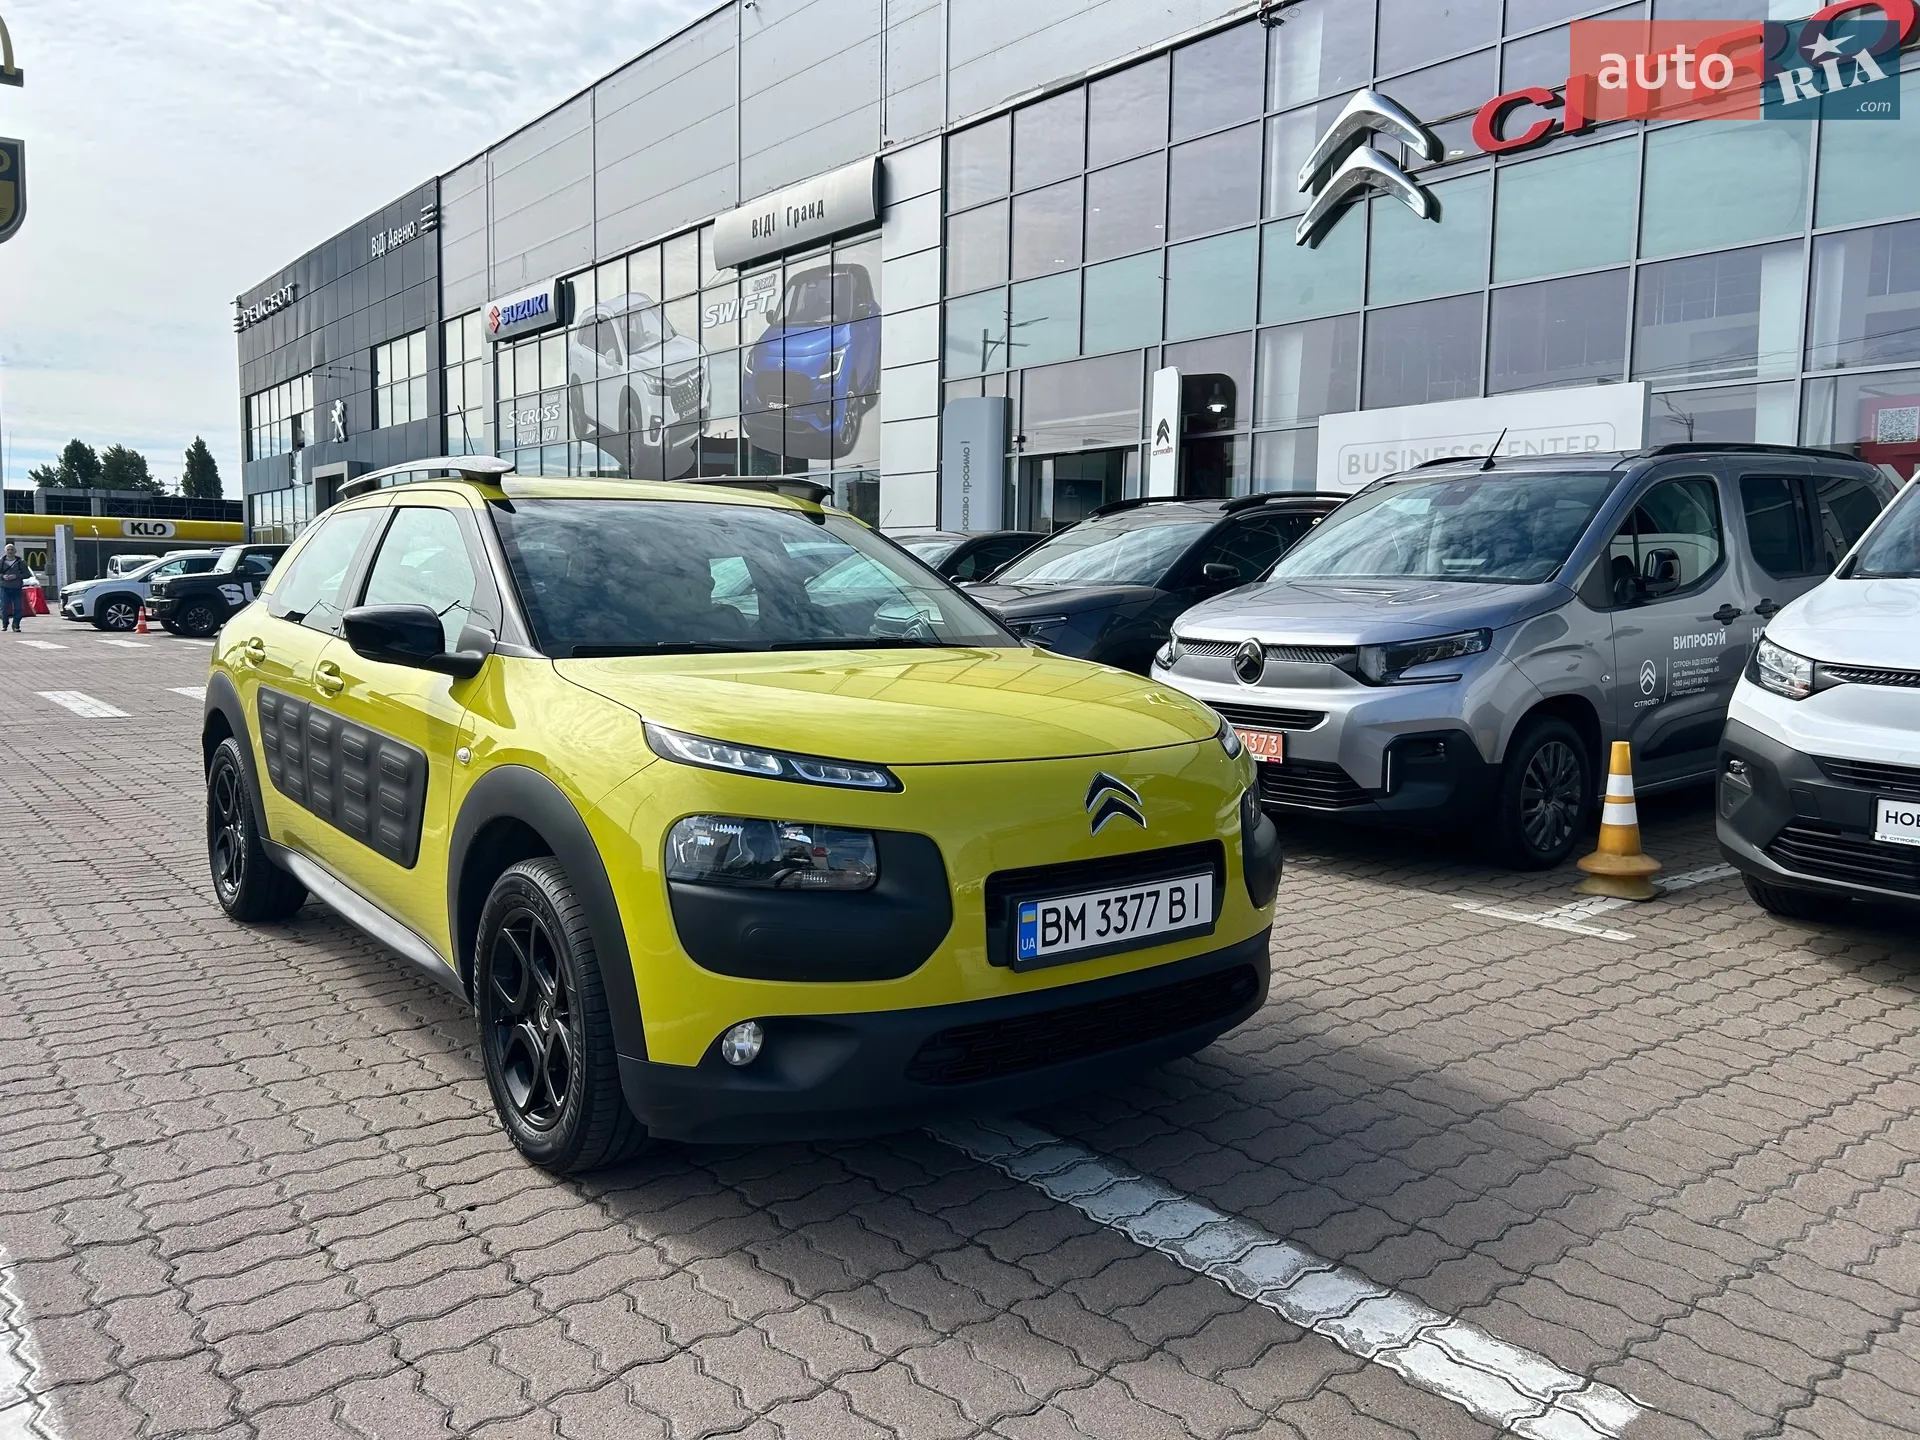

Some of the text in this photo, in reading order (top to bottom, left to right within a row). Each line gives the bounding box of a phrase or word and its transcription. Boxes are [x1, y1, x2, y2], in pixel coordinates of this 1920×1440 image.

[388, 220, 415, 250] Авеню
[752, 199, 824, 238] ВІДІ Гранд
[243, 282, 294, 329] PEUGEOT
[501, 293, 549, 325] SUZUKI
[703, 288, 776, 329] SWIFT
[962, 447, 972, 494] просимо
[130, 522, 167, 536] KLO
[1673, 628, 1726, 650] ВИПРОБУЙ
[1041, 882, 1199, 947] BM 3377 BI
[1021, 937, 1036, 951] UA
